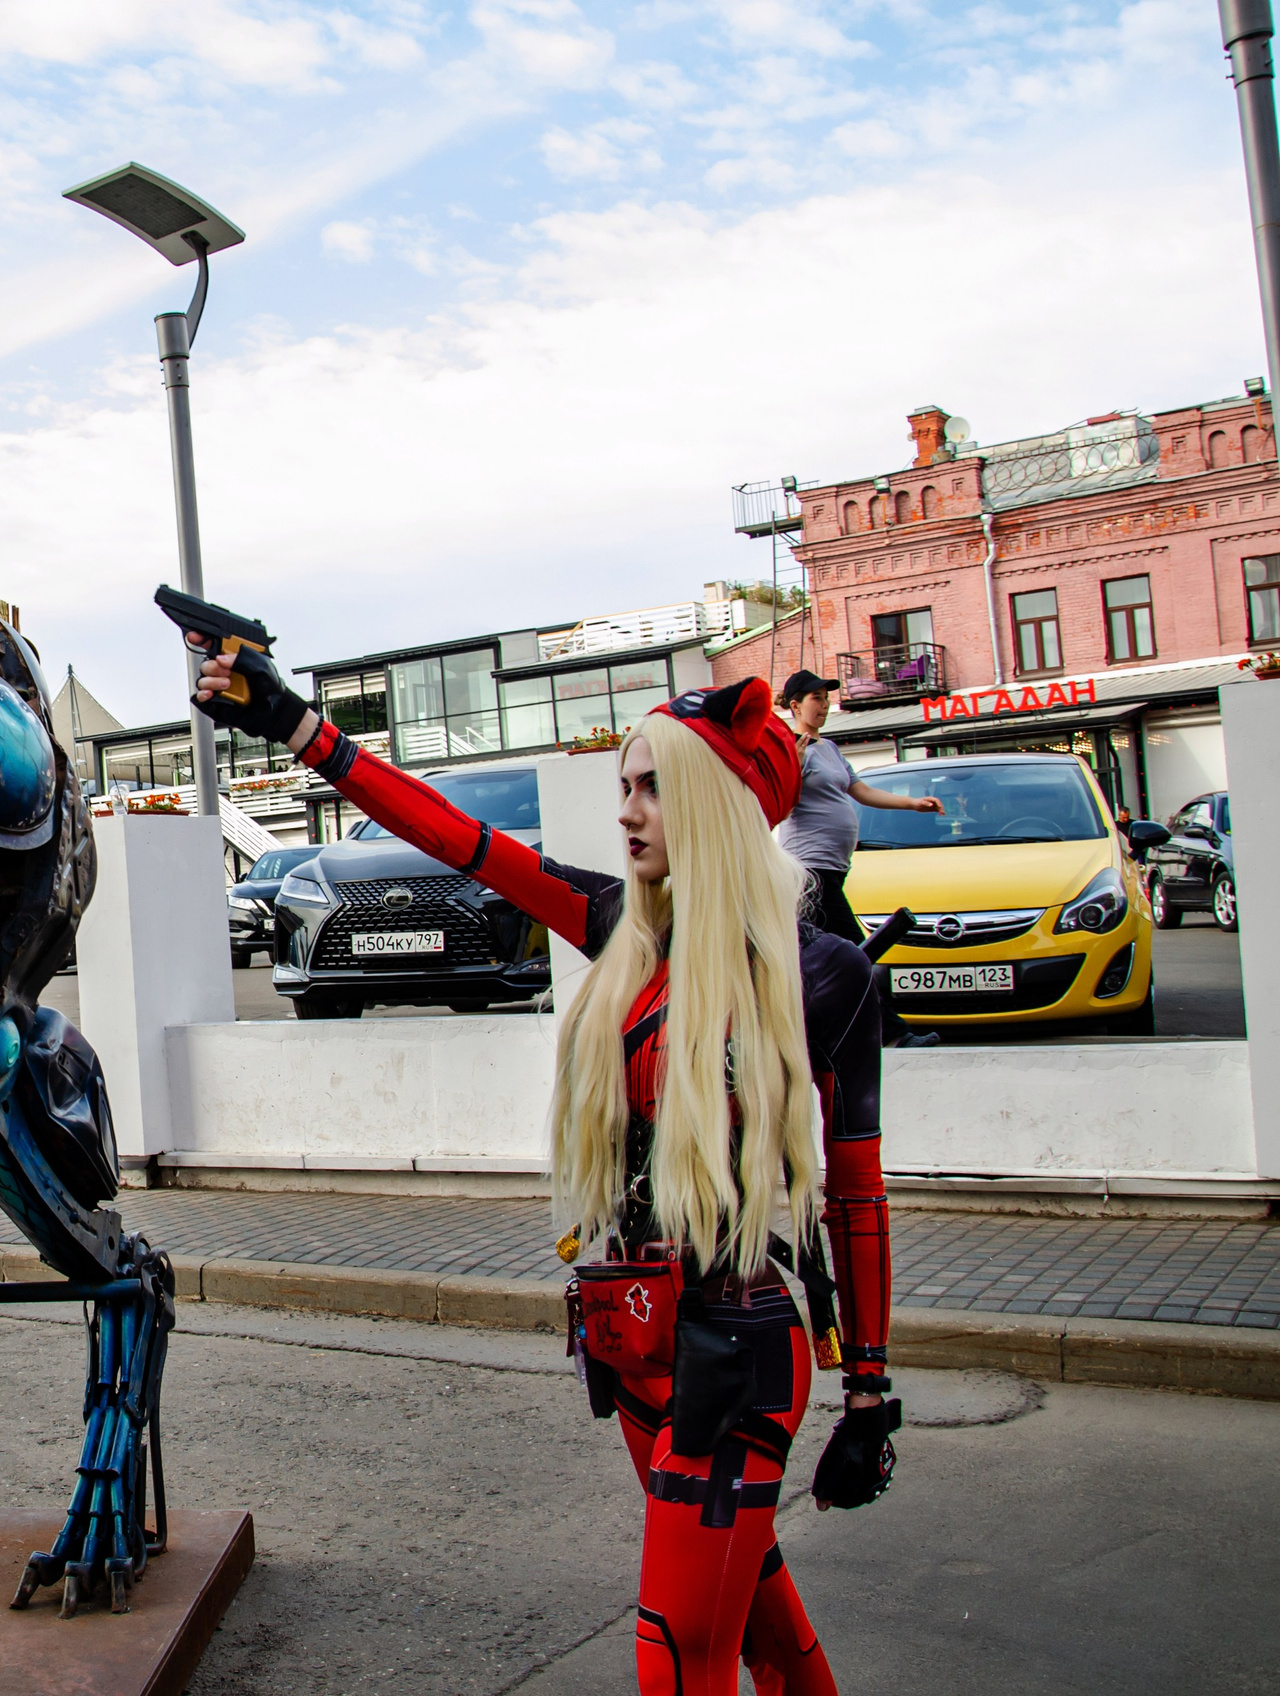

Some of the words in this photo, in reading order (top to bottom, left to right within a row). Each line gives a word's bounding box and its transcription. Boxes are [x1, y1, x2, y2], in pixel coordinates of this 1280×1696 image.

[920, 679, 1097, 723] МАГАДАН
[357, 936, 414, 952] Н504КУ
[417, 933, 439, 946] 797
[897, 971, 974, 990] С987МВ
[978, 968, 1007, 982] 123
